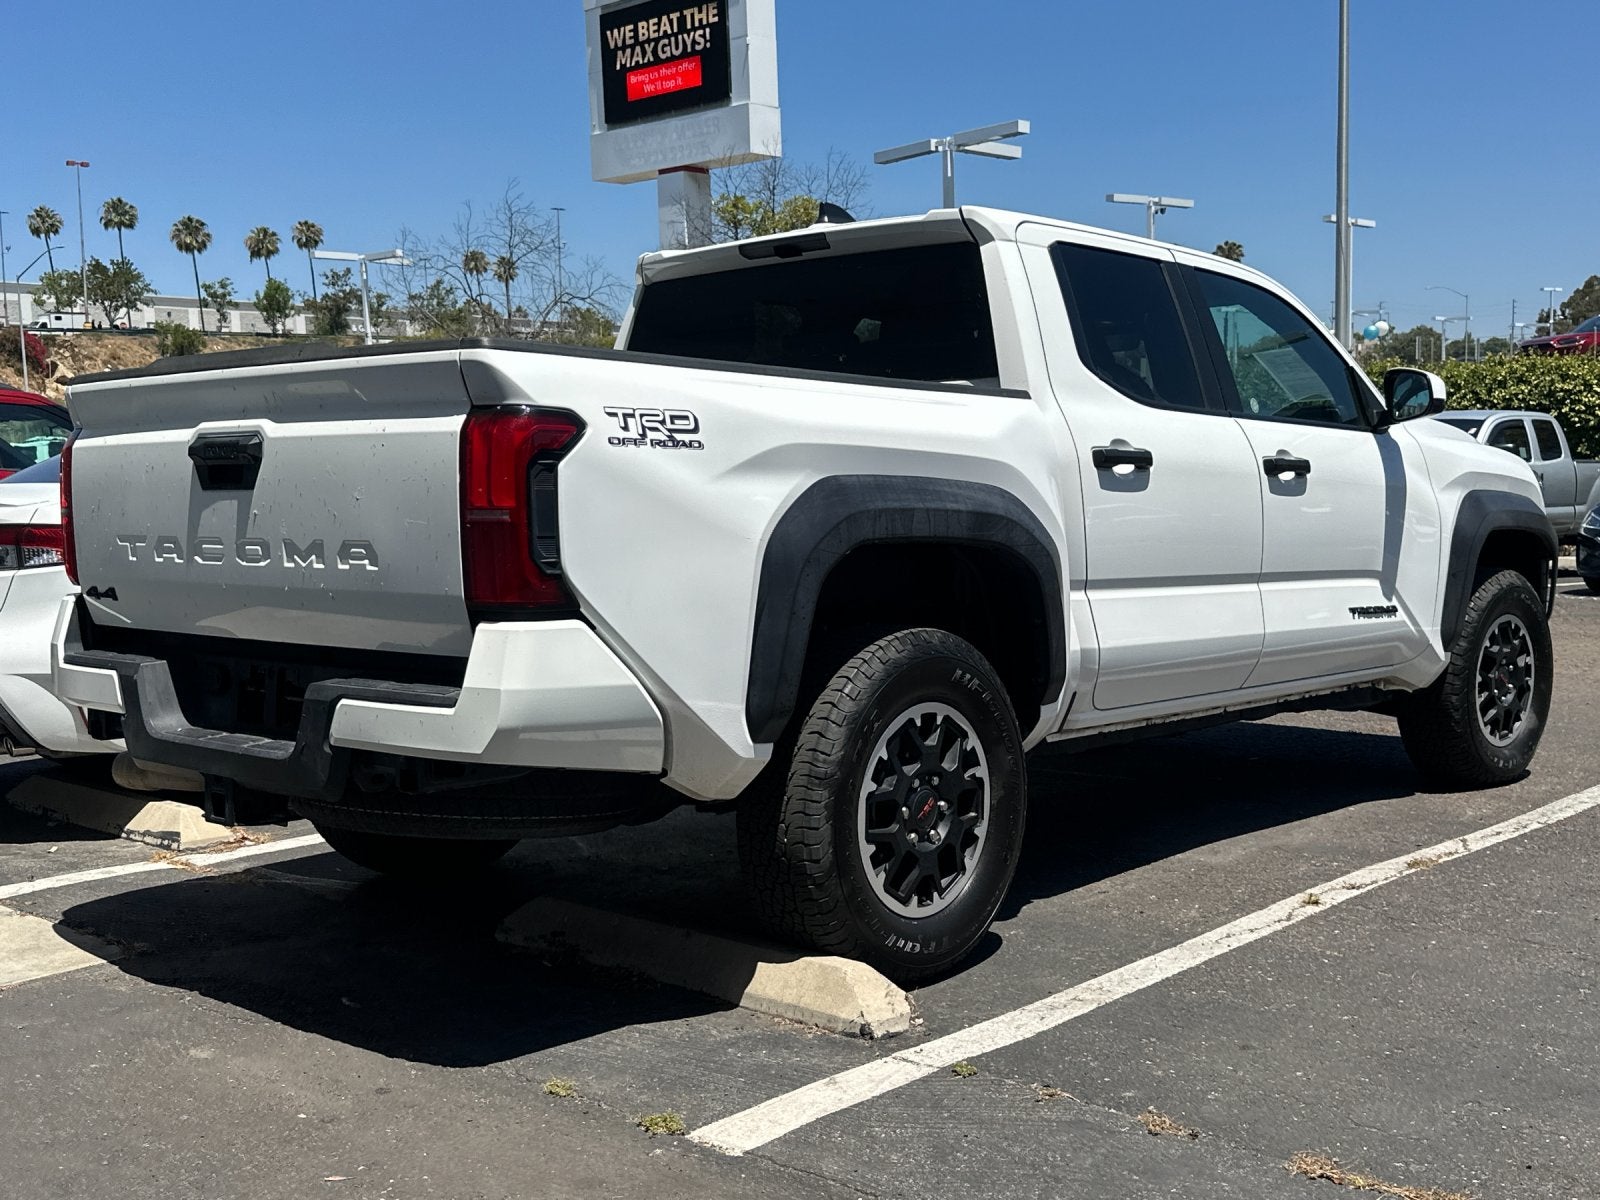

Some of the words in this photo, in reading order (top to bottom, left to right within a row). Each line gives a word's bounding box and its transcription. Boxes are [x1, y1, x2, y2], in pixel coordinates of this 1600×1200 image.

[606, 24, 635, 49] WE
[638, 12, 680, 42] BEAT
[683, 2, 719, 29] THE
[616, 42, 655, 70] MAX
[658, 28, 711, 59] GUYS!
[630, 71, 649, 84] Bring
[650, 72, 659, 80] us
[660, 66, 677, 78] their
[677, 62, 696, 73] offer
[662, 79, 676, 90] top
[603, 406, 700, 439] TRD
[608, 437, 647, 448] OFF
[650, 439, 704, 450] ROAD
[116, 535, 379, 571] TACOMA
